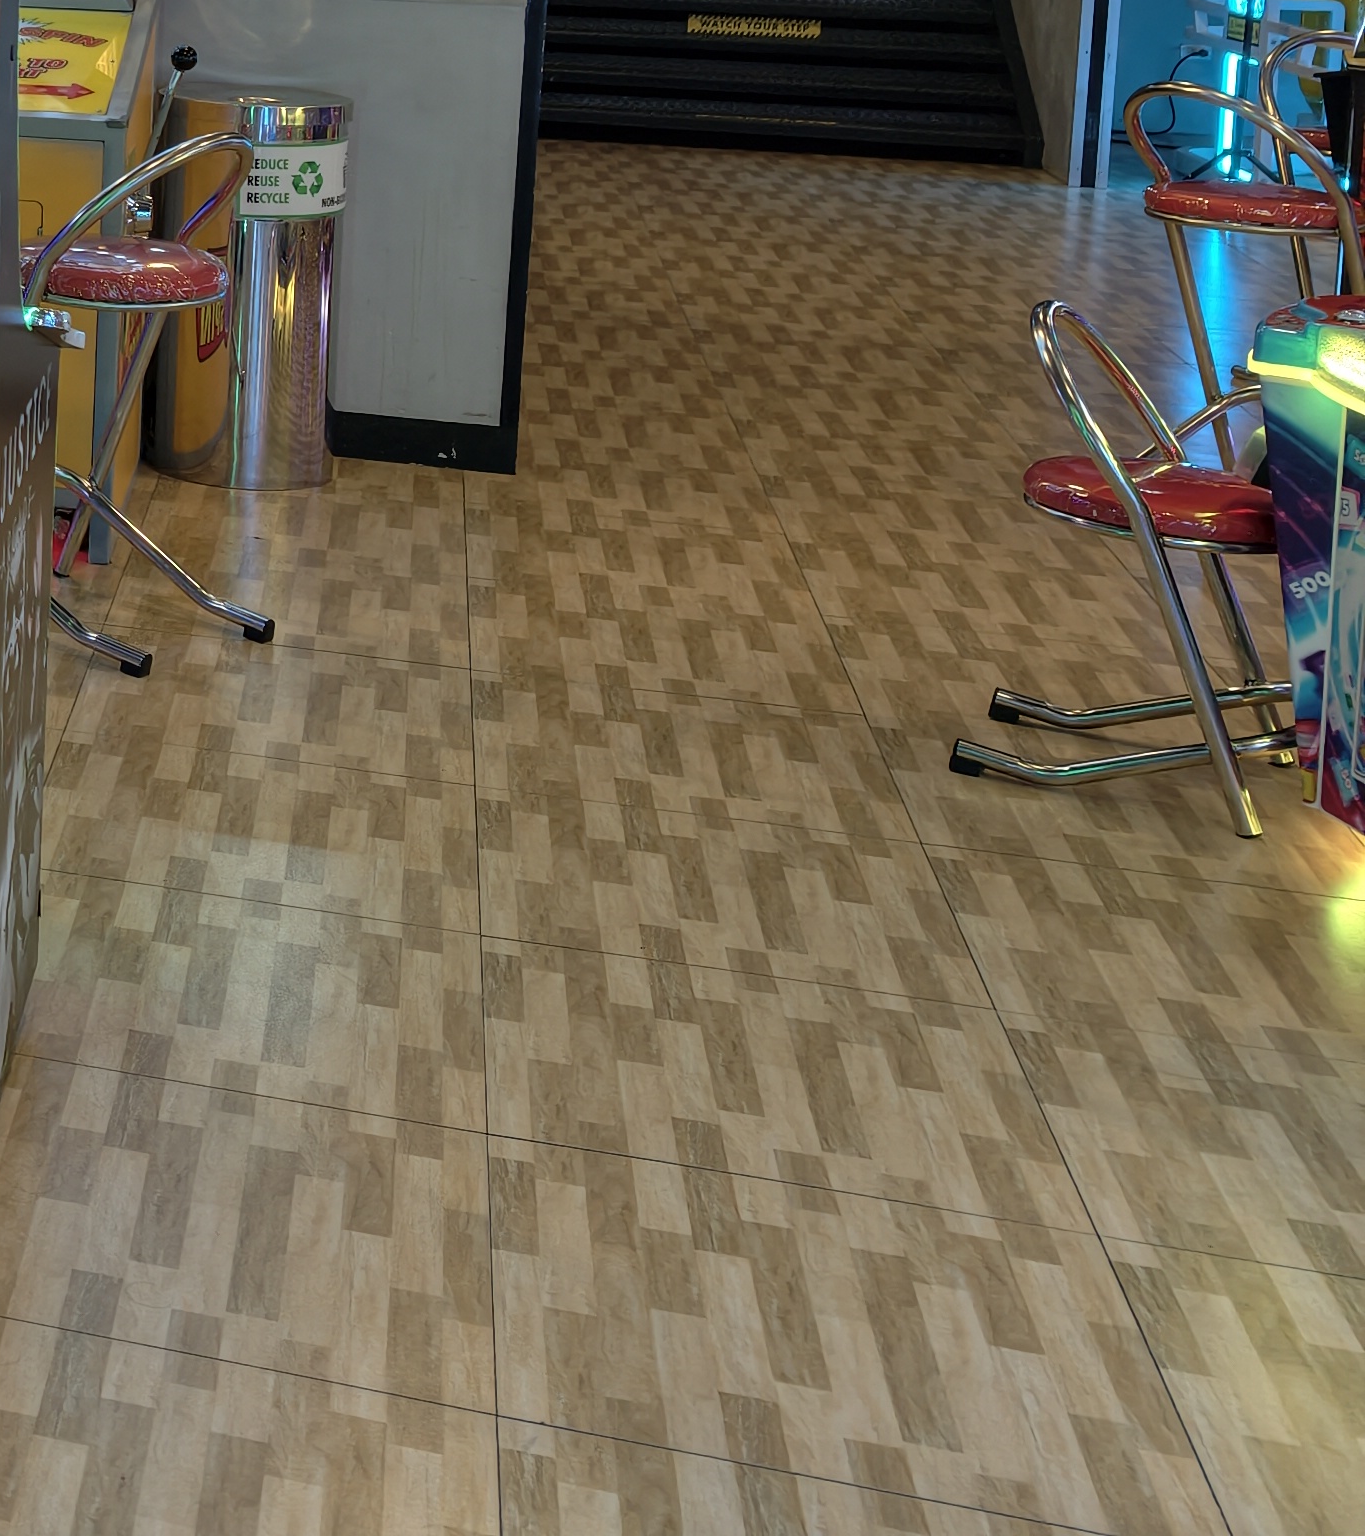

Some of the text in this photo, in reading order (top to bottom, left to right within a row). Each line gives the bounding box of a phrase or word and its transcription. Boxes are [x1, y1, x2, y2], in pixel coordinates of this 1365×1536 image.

[745, 21, 779, 32] YOUR
[19, 26, 108, 48] SPIN
[27, 57, 69, 69] TO
[247, 175, 280, 188] REUSE
[246, 192, 290, 205] RECYCLE
[1288, 574, 1331, 601] 500
